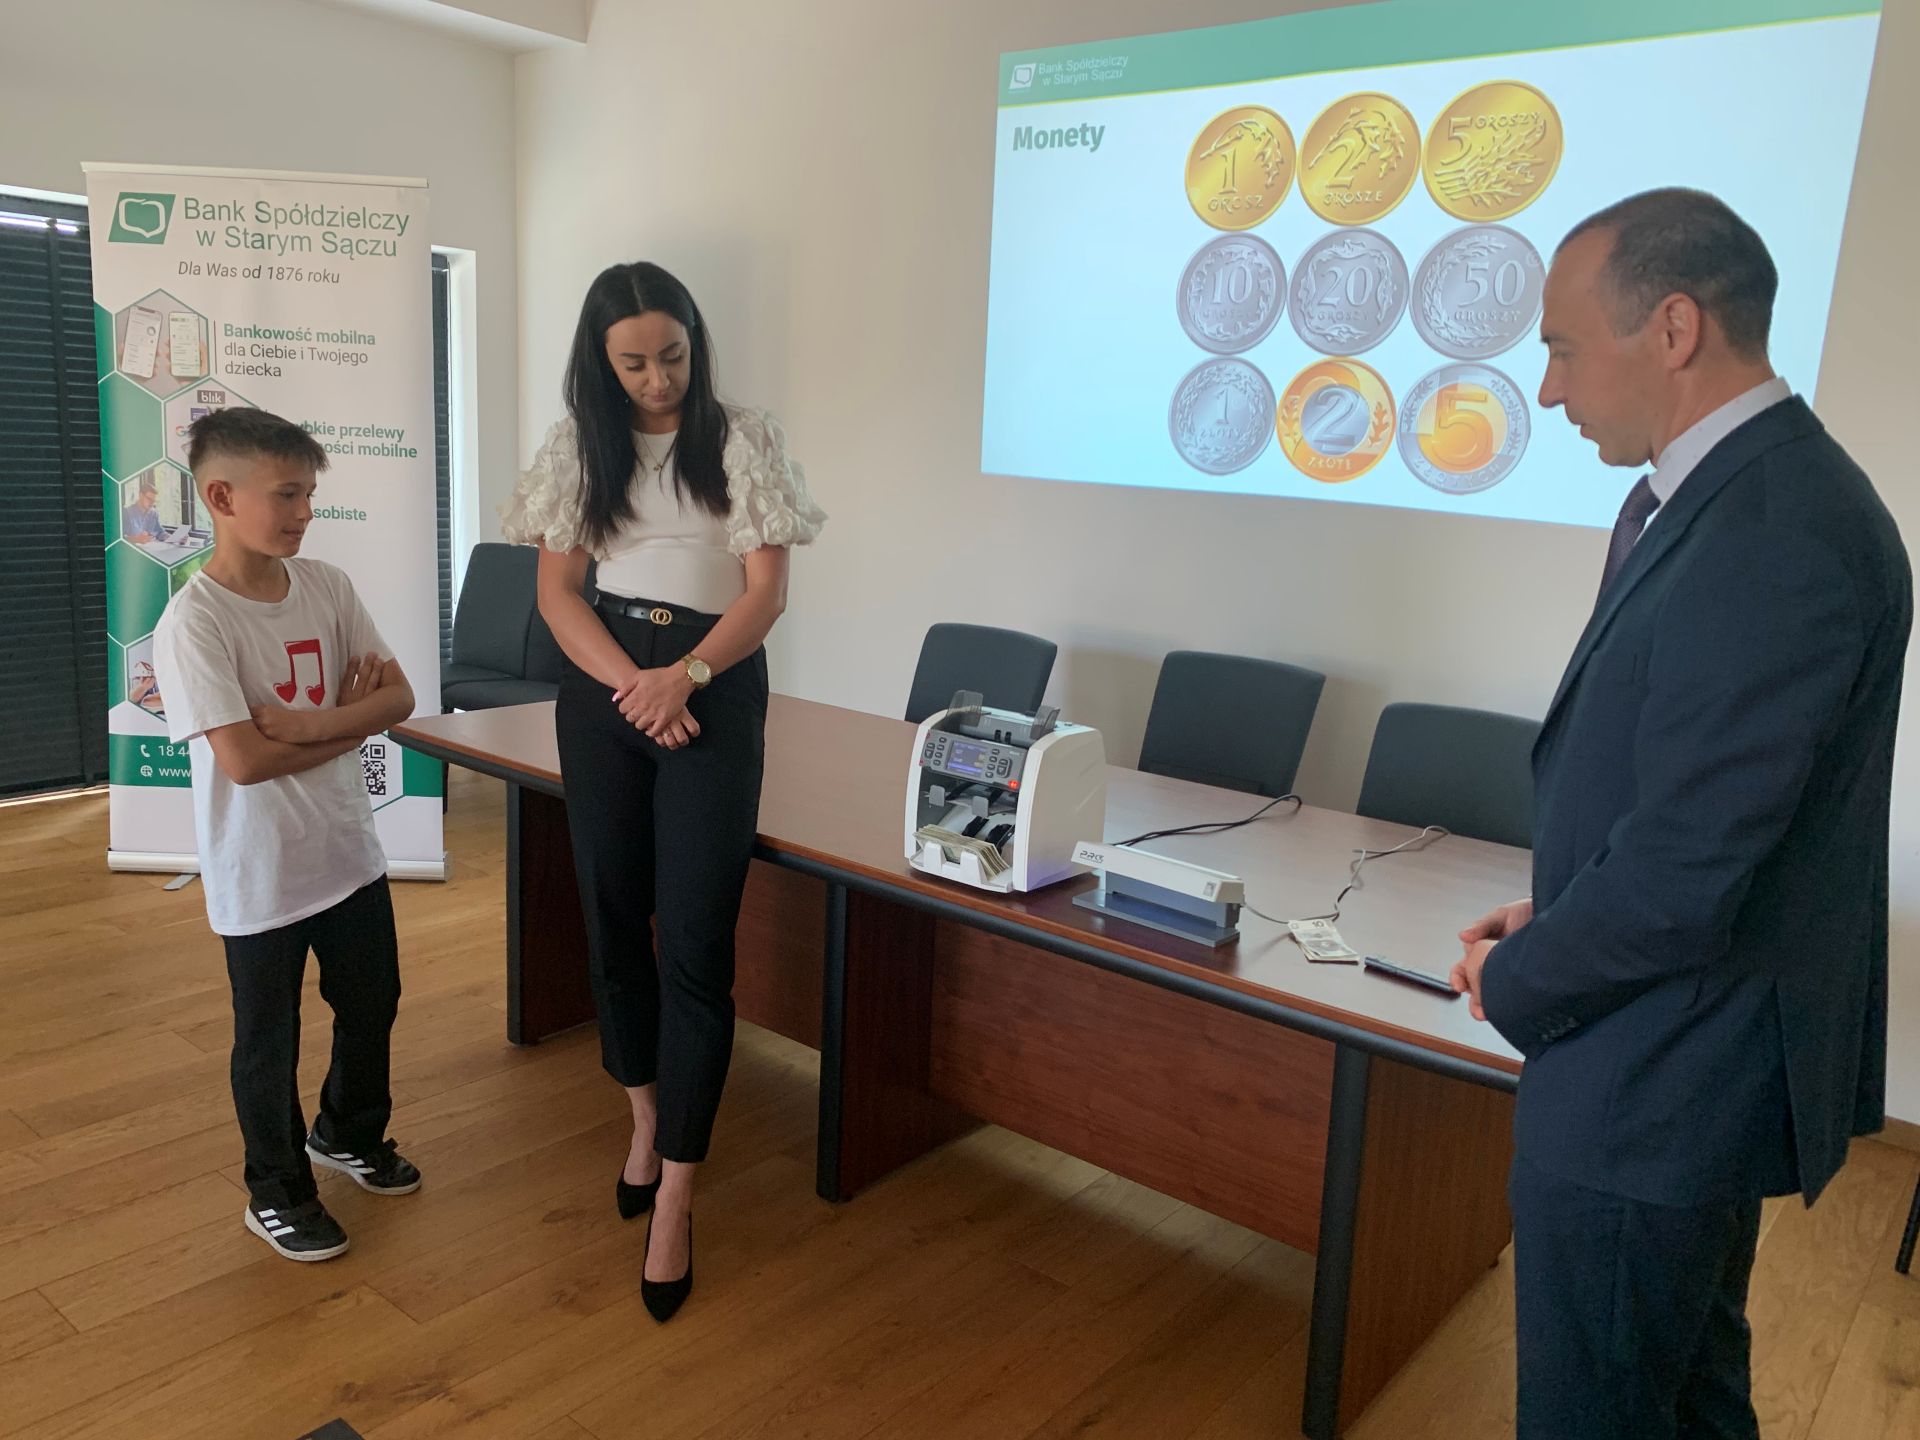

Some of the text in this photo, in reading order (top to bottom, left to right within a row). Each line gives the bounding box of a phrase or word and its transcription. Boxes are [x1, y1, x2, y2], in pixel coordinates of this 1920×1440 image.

[1038, 55, 1129, 75] Bank Spółdzielczy
[1042, 68, 1123, 87] w Starym Sączu
[1012, 122, 1106, 153] Monety
[1440, 111, 1541, 166] 5 GROSZY
[1216, 147, 1239, 196] 1
[1325, 137, 1356, 189] 2
[1207, 194, 1264, 214] GROSZ
[1323, 189, 1383, 208] GROSZE
[184, 197, 410, 237] Bank Spółdzielczy
[196, 225, 397, 261] w Starym Sączu
[178, 261, 340, 284] Dla Was od 1876 roku
[1210, 264, 1252, 305] 10
[1457, 259, 1526, 308] 50
[1317, 266, 1373, 307] 20
[1317, 309, 1370, 324] GROSZY
[1453, 308, 1521, 324] GROSZY
[223, 323, 376, 346] Bankowość mobilna
[224, 342, 369, 367] dla Ciebie i Twojego
[224, 360, 282, 377] dziecka
[201, 391, 222, 403] blik
[1212, 387, 1230, 425] 1
[1310, 386, 1360, 450] 2
[339, 423, 405, 443] przelewy
[1432, 391, 1491, 470] 5
[358, 442, 418, 459] mobilne
[158, 745, 175, 757] 18
